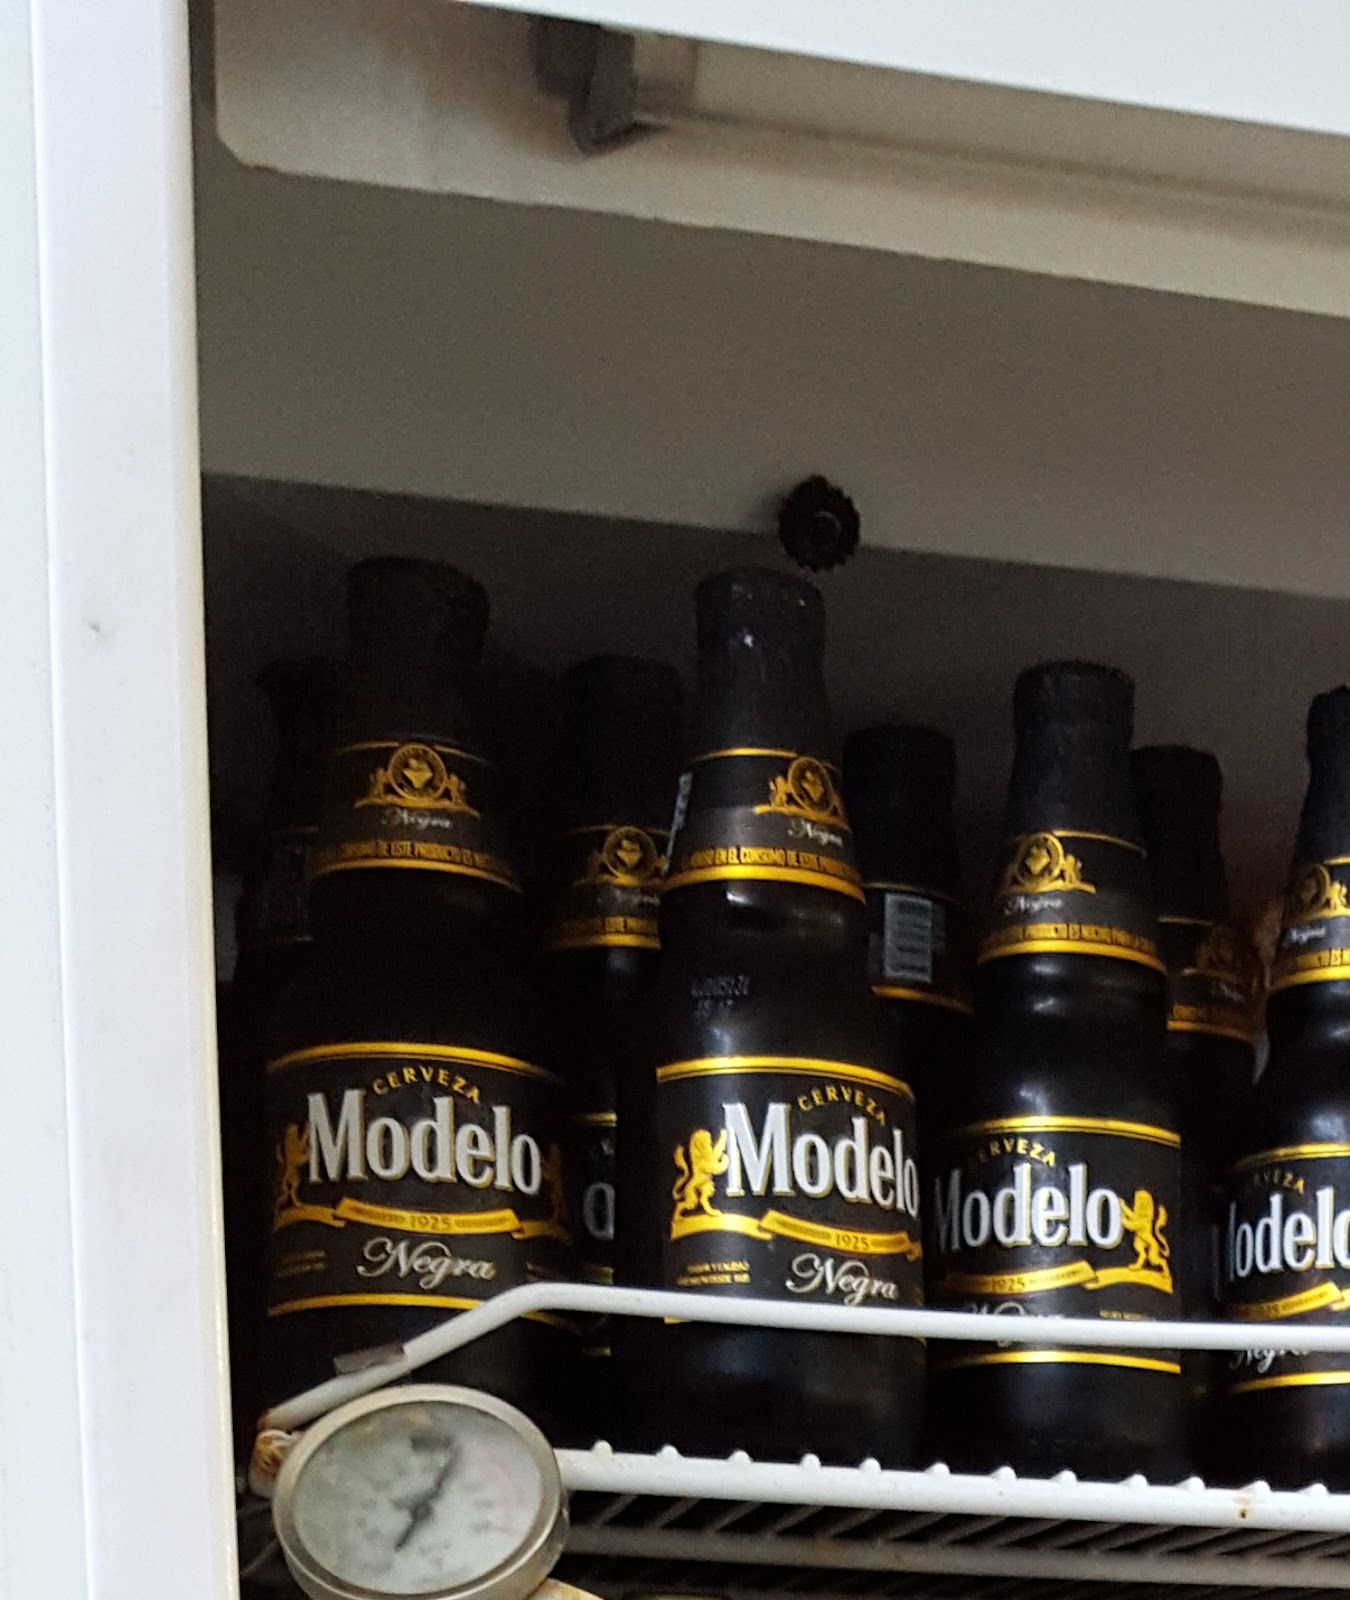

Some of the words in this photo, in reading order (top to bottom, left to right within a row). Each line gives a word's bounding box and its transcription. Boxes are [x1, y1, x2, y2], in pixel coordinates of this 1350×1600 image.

[373, 1065, 480, 1104] CERVEZA
[798, 1085, 886, 1126] CERVEZA
[307, 1088, 543, 1195] Modelo
[722, 1101, 920, 1218] Modelo
[978, 1137, 1056, 1167] RVEZA
[410, 1214, 451, 1231] 1925
[835, 1232, 871, 1250] 1925
[356, 1236, 497, 1290] Negra
[786, 1252, 898, 1306] Negra
